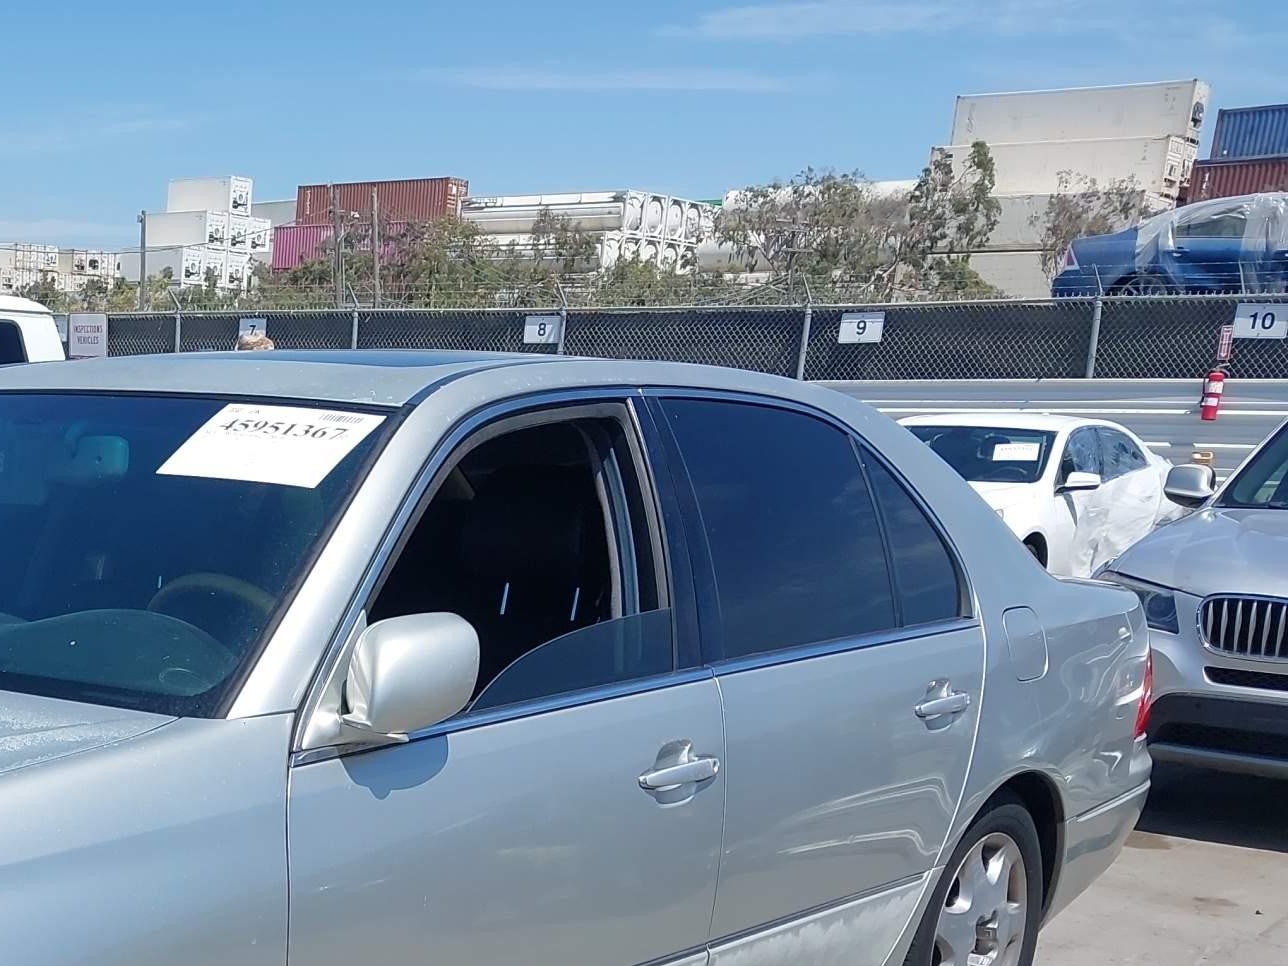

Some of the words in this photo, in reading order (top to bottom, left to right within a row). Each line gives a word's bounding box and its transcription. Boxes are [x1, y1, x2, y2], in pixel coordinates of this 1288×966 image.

[856, 320, 867, 335] 9
[1249, 312, 1276, 330] 10
[249, 324, 257, 336] 7
[538, 323, 547, 336] 8
[219, 418, 350, 440] 45951367
